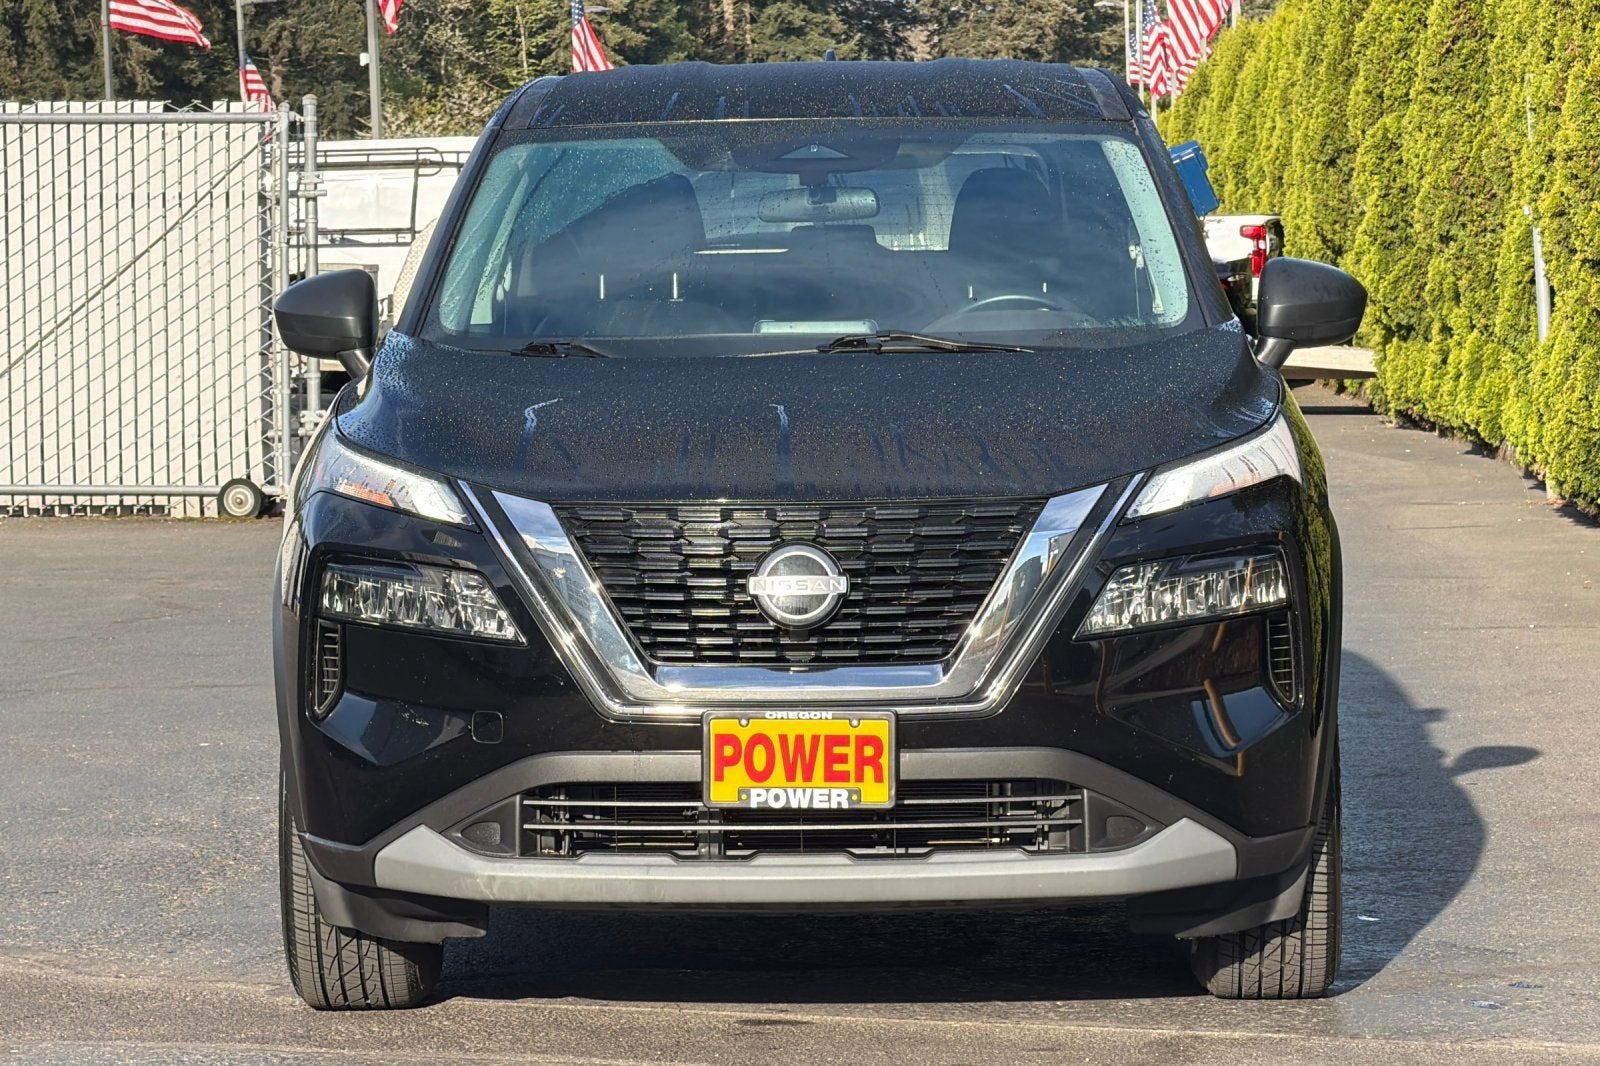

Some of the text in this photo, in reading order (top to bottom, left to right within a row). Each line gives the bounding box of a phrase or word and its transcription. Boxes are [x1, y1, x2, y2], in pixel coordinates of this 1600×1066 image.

[753, 579, 844, 592] NISSAN
[765, 711, 833, 720] OREGON
[714, 732, 884, 783] POWER
[749, 787, 849, 809] POWER
